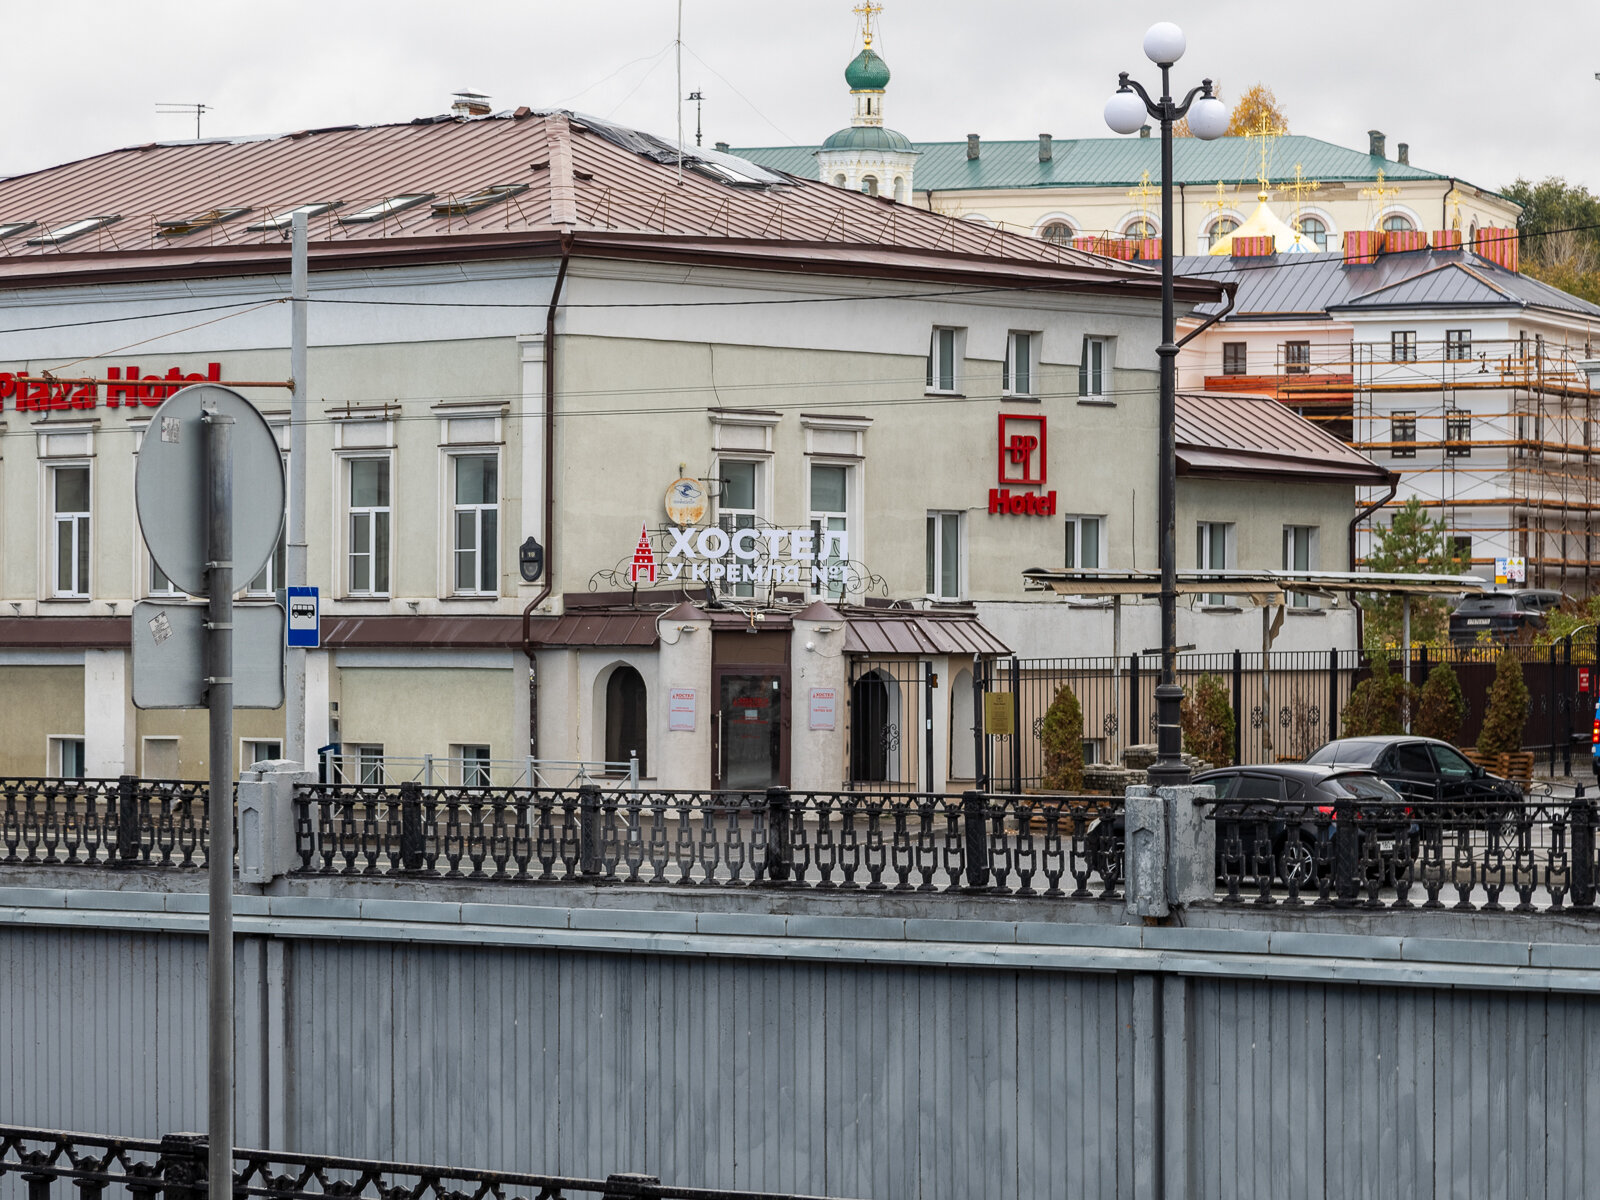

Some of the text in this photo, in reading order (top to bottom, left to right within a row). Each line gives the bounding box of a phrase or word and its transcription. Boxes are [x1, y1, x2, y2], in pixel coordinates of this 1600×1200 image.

[0, 371, 97, 412] Plaza
[988, 489, 1057, 516] Hotel
[667, 527, 848, 561] ХОСТЕЛ
[666, 562, 848, 584] У КРЕМЛЯ №1
